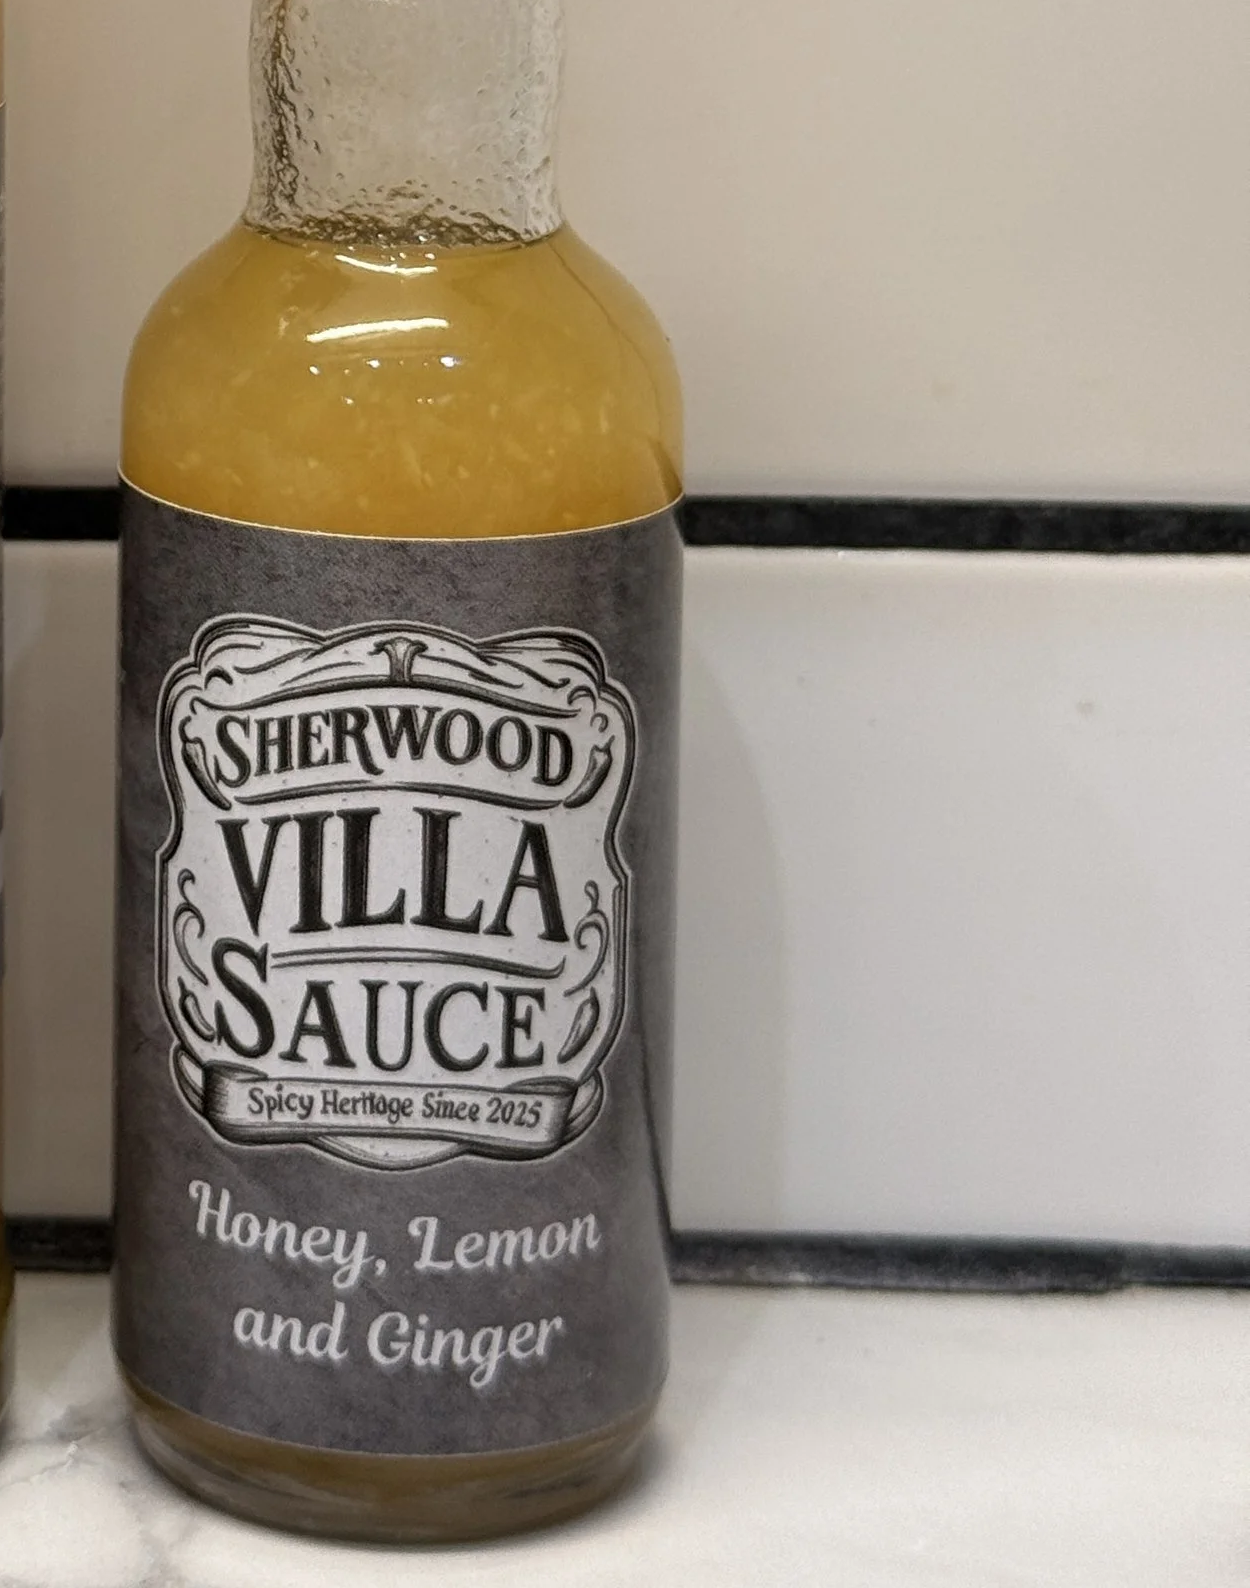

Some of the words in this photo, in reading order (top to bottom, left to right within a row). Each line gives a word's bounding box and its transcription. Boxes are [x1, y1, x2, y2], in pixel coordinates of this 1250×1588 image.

[213, 704, 574, 789] SHERWOOD
[215, 806, 570, 944] VILLA
[210, 937, 546, 1072] SAUCE
[247, 1083, 315, 1121] Spicy
[485, 1095, 544, 1129] 2025
[187, 1178, 388, 1290] Honey,
[406, 1213, 602, 1274] Lemon
[232, 1299, 350, 1363] and
[365, 1311, 565, 1390] Ginger
